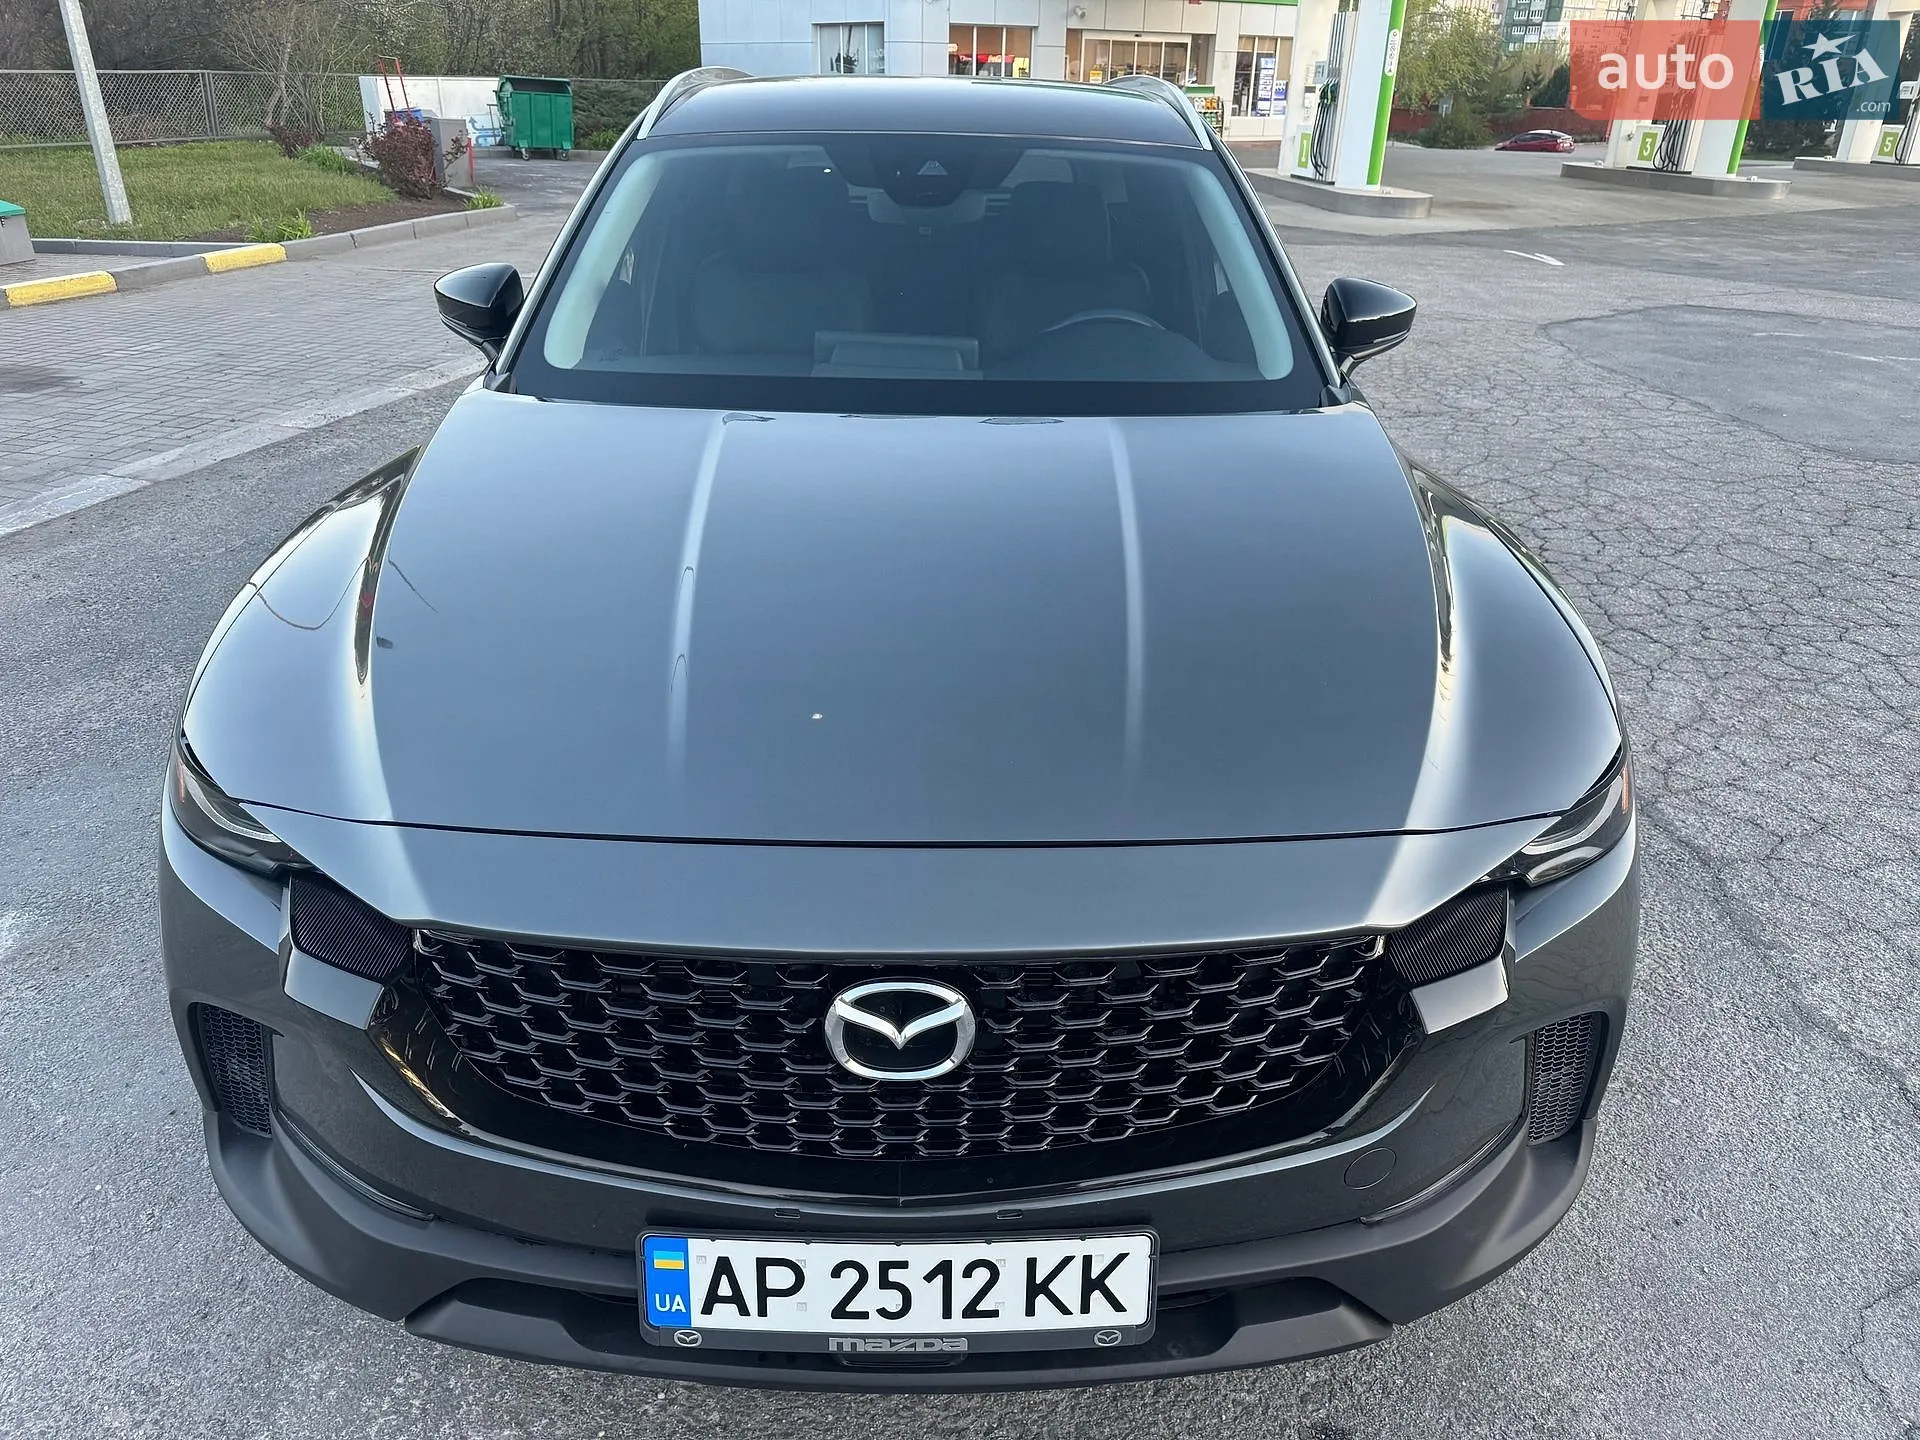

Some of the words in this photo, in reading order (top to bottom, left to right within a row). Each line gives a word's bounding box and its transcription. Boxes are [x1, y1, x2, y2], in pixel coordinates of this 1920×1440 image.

[1301, 139, 1308, 162] 1
[1643, 137, 1652, 157] 3
[1883, 136, 1893, 153] 5
[700, 1255, 806, 1318] AP
[830, 1257, 1001, 1321] 2512
[1024, 1252, 1132, 1318] KK
[655, 1294, 687, 1314] UA
